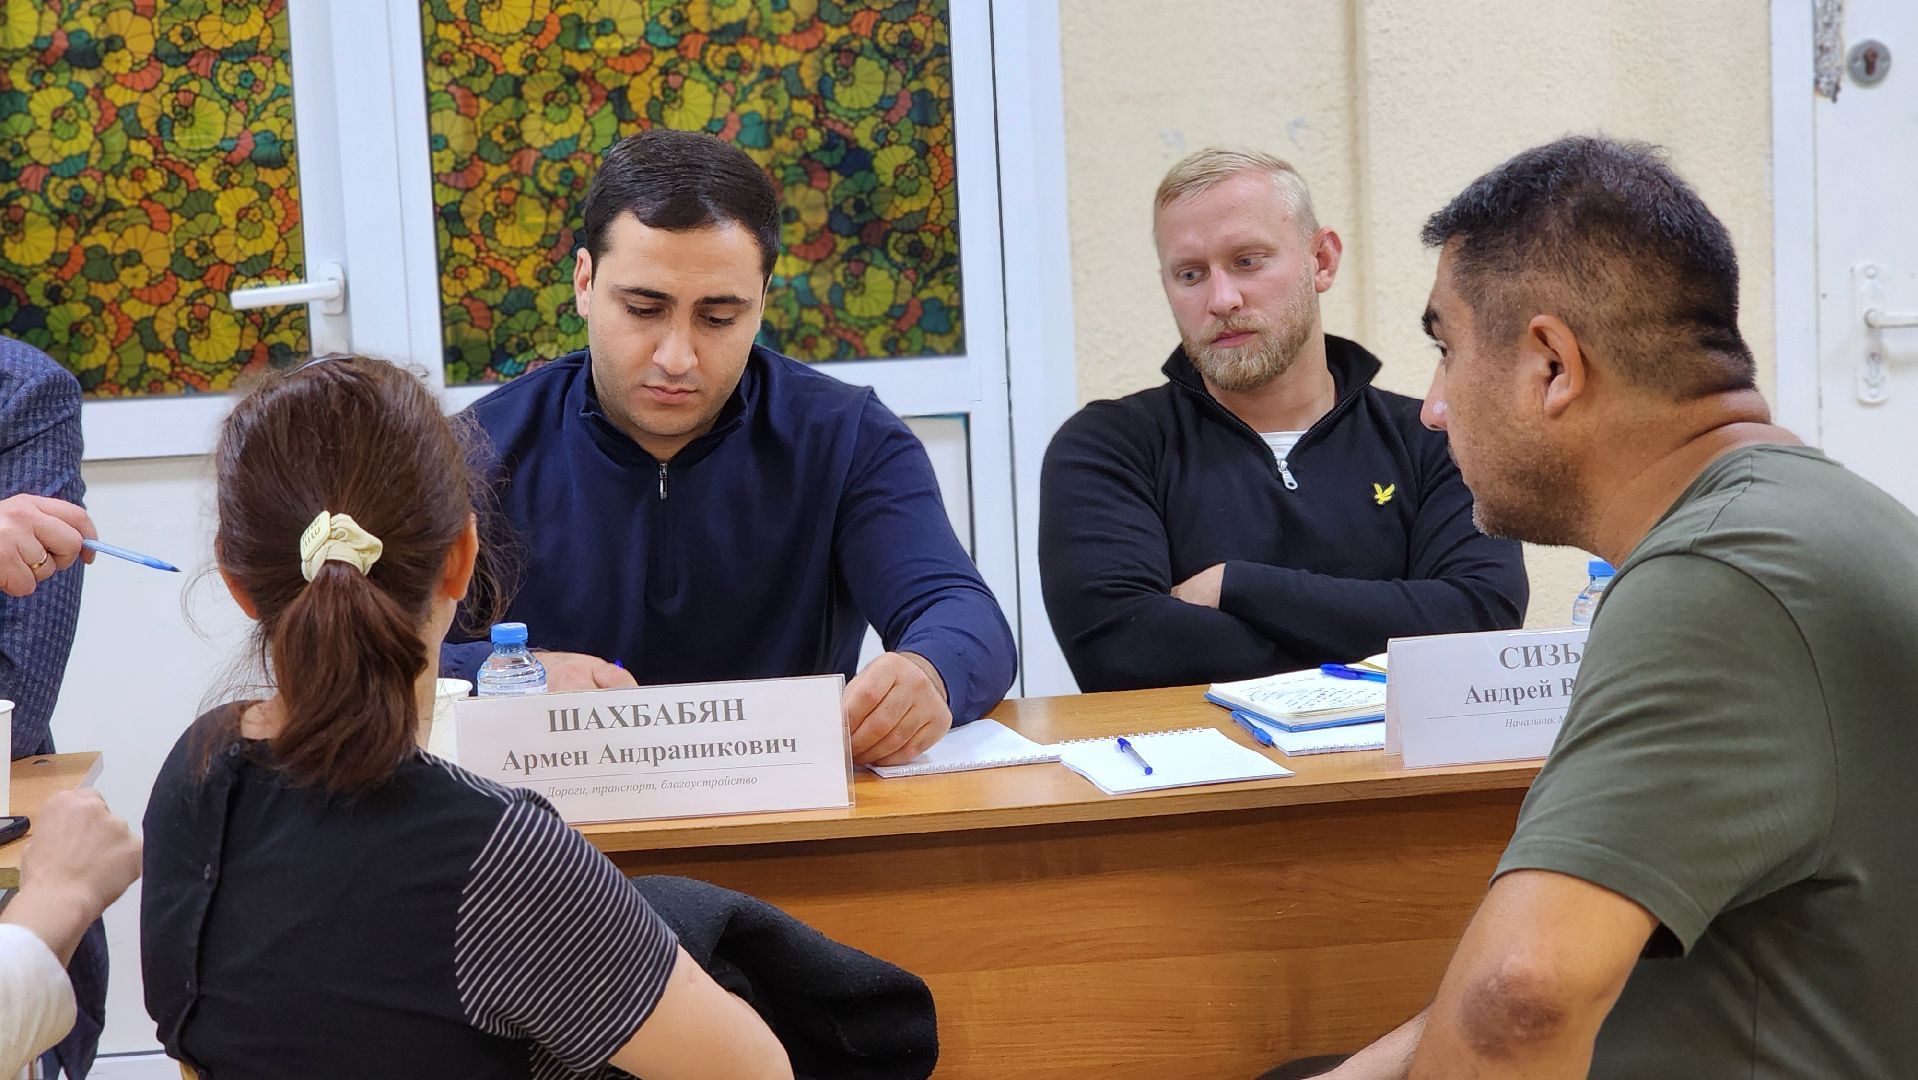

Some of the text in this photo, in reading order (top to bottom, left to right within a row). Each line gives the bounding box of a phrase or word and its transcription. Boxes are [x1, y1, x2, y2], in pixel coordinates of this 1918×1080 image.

[1465, 679, 1553, 705] Андрей
[547, 698, 746, 733] ШАХБАБЯН
[1505, 717, 1555, 728] Начальник
[502, 738, 798, 776] Армен Андраникович
[546, 775, 758, 798] Дороги, транспорт, благоустройство
